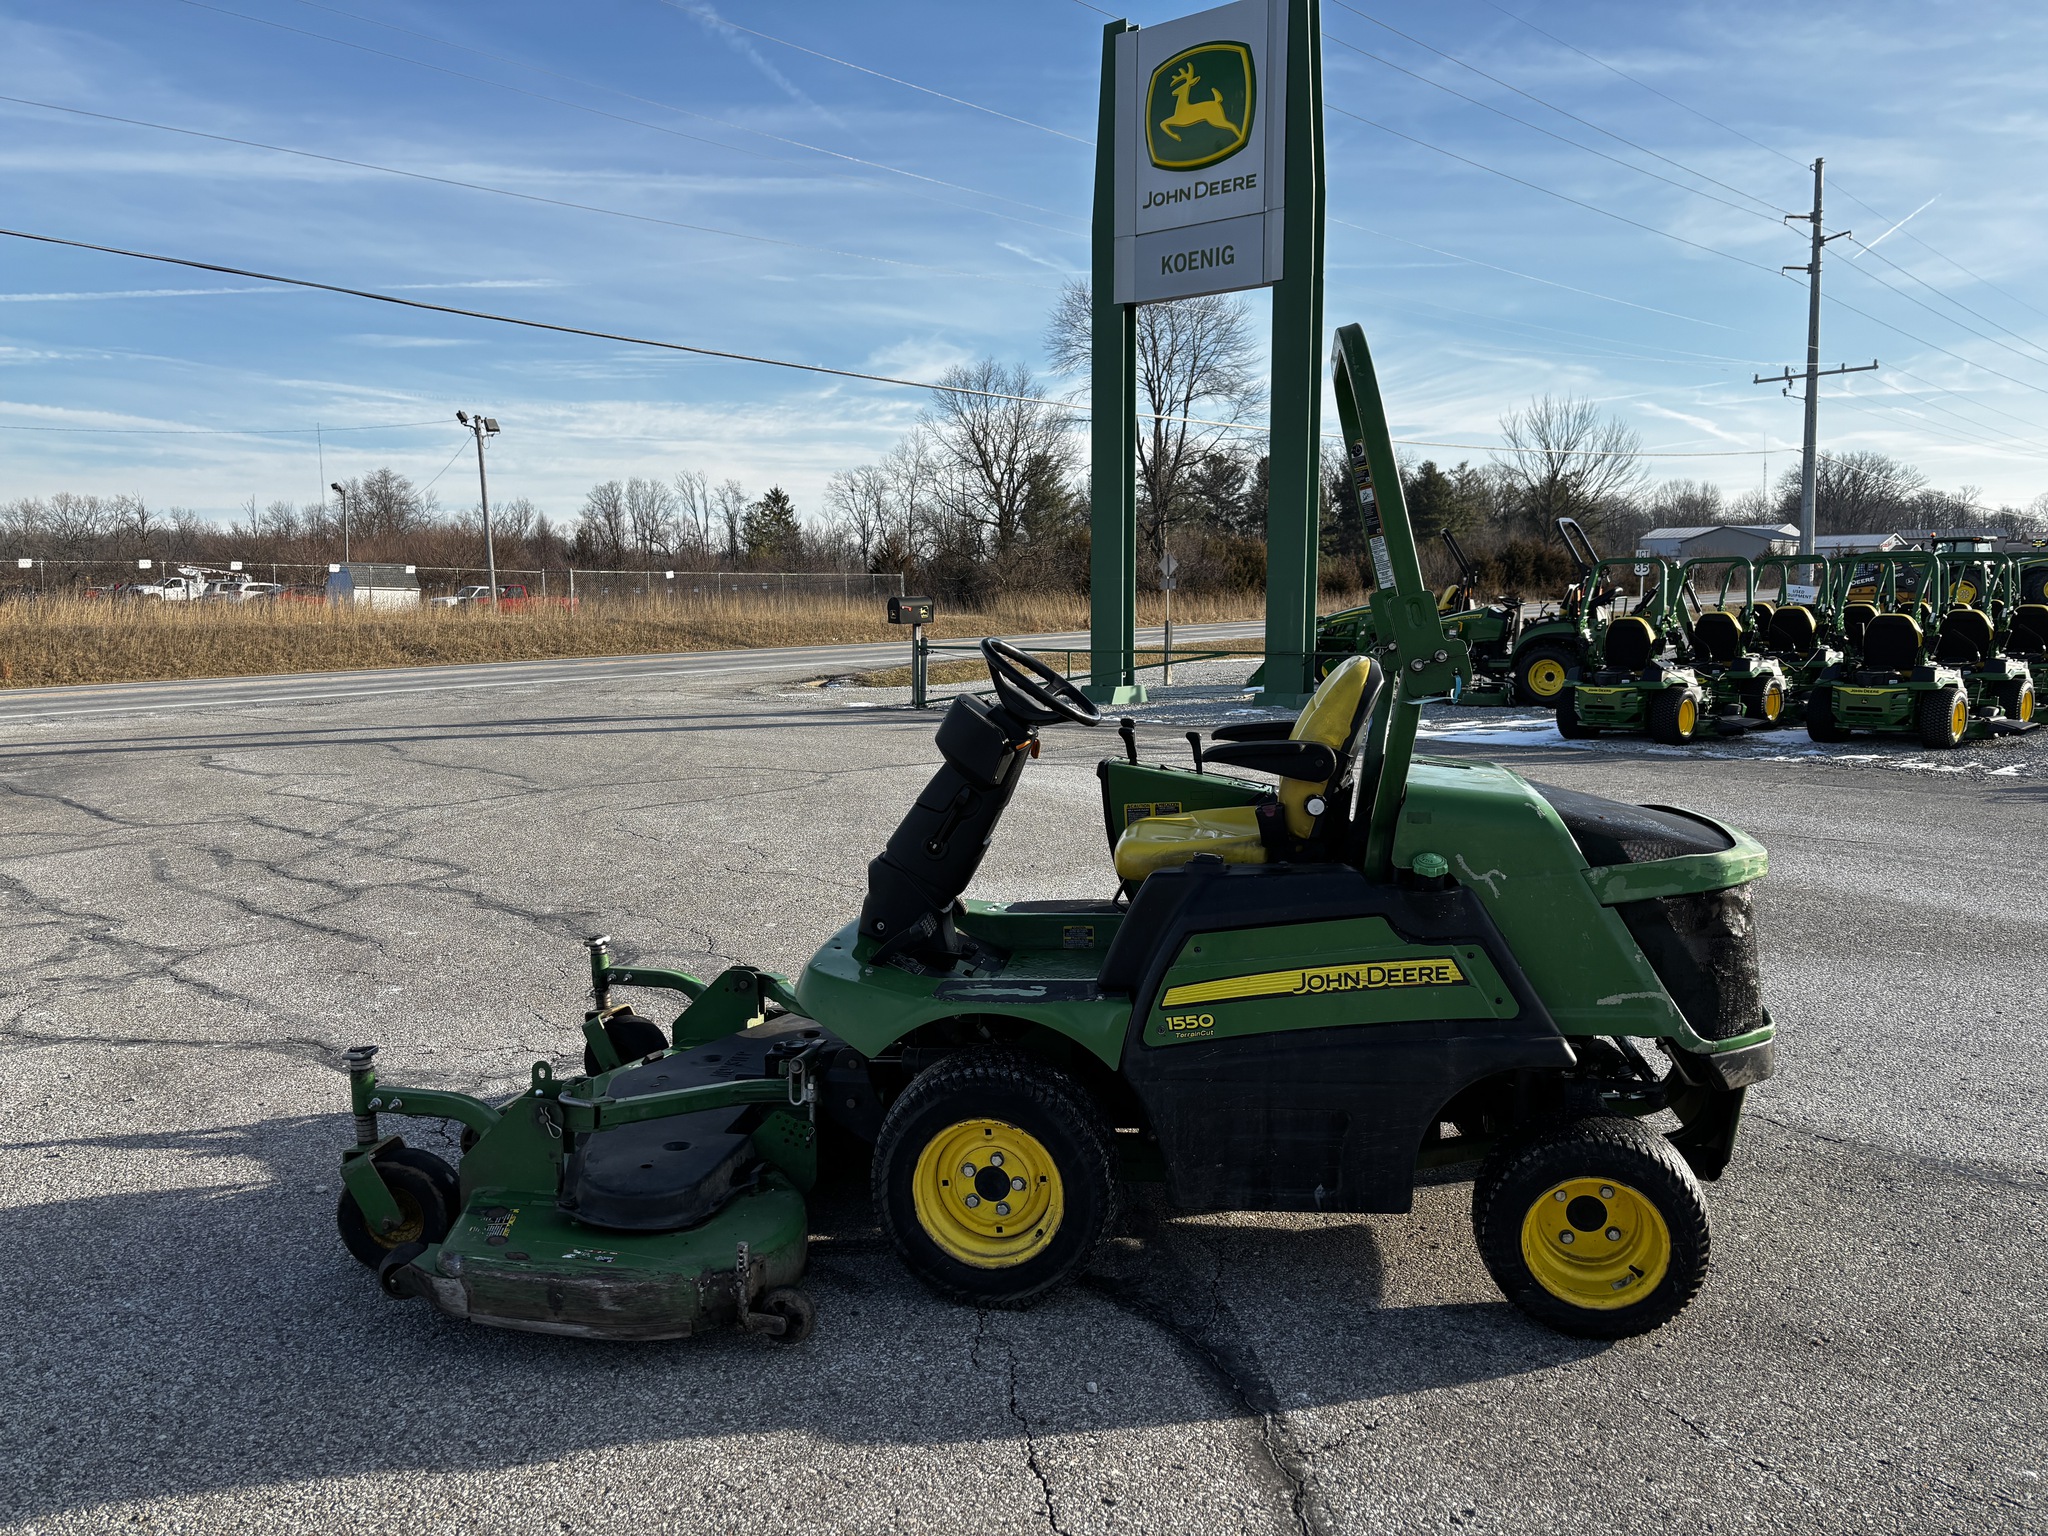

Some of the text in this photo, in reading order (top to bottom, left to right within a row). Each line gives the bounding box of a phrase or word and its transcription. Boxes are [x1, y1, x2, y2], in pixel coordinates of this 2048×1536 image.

[1142, 173, 1257, 209] JOHN DEERE
[1161, 245, 1235, 275] KOENIG
[1635, 564, 1649, 572] 35
[1292, 965, 1451, 993] JOHN DEERE
[1165, 1013, 1215, 1031] 1550
[1175, 1030, 1214, 1038] TerrainCut
